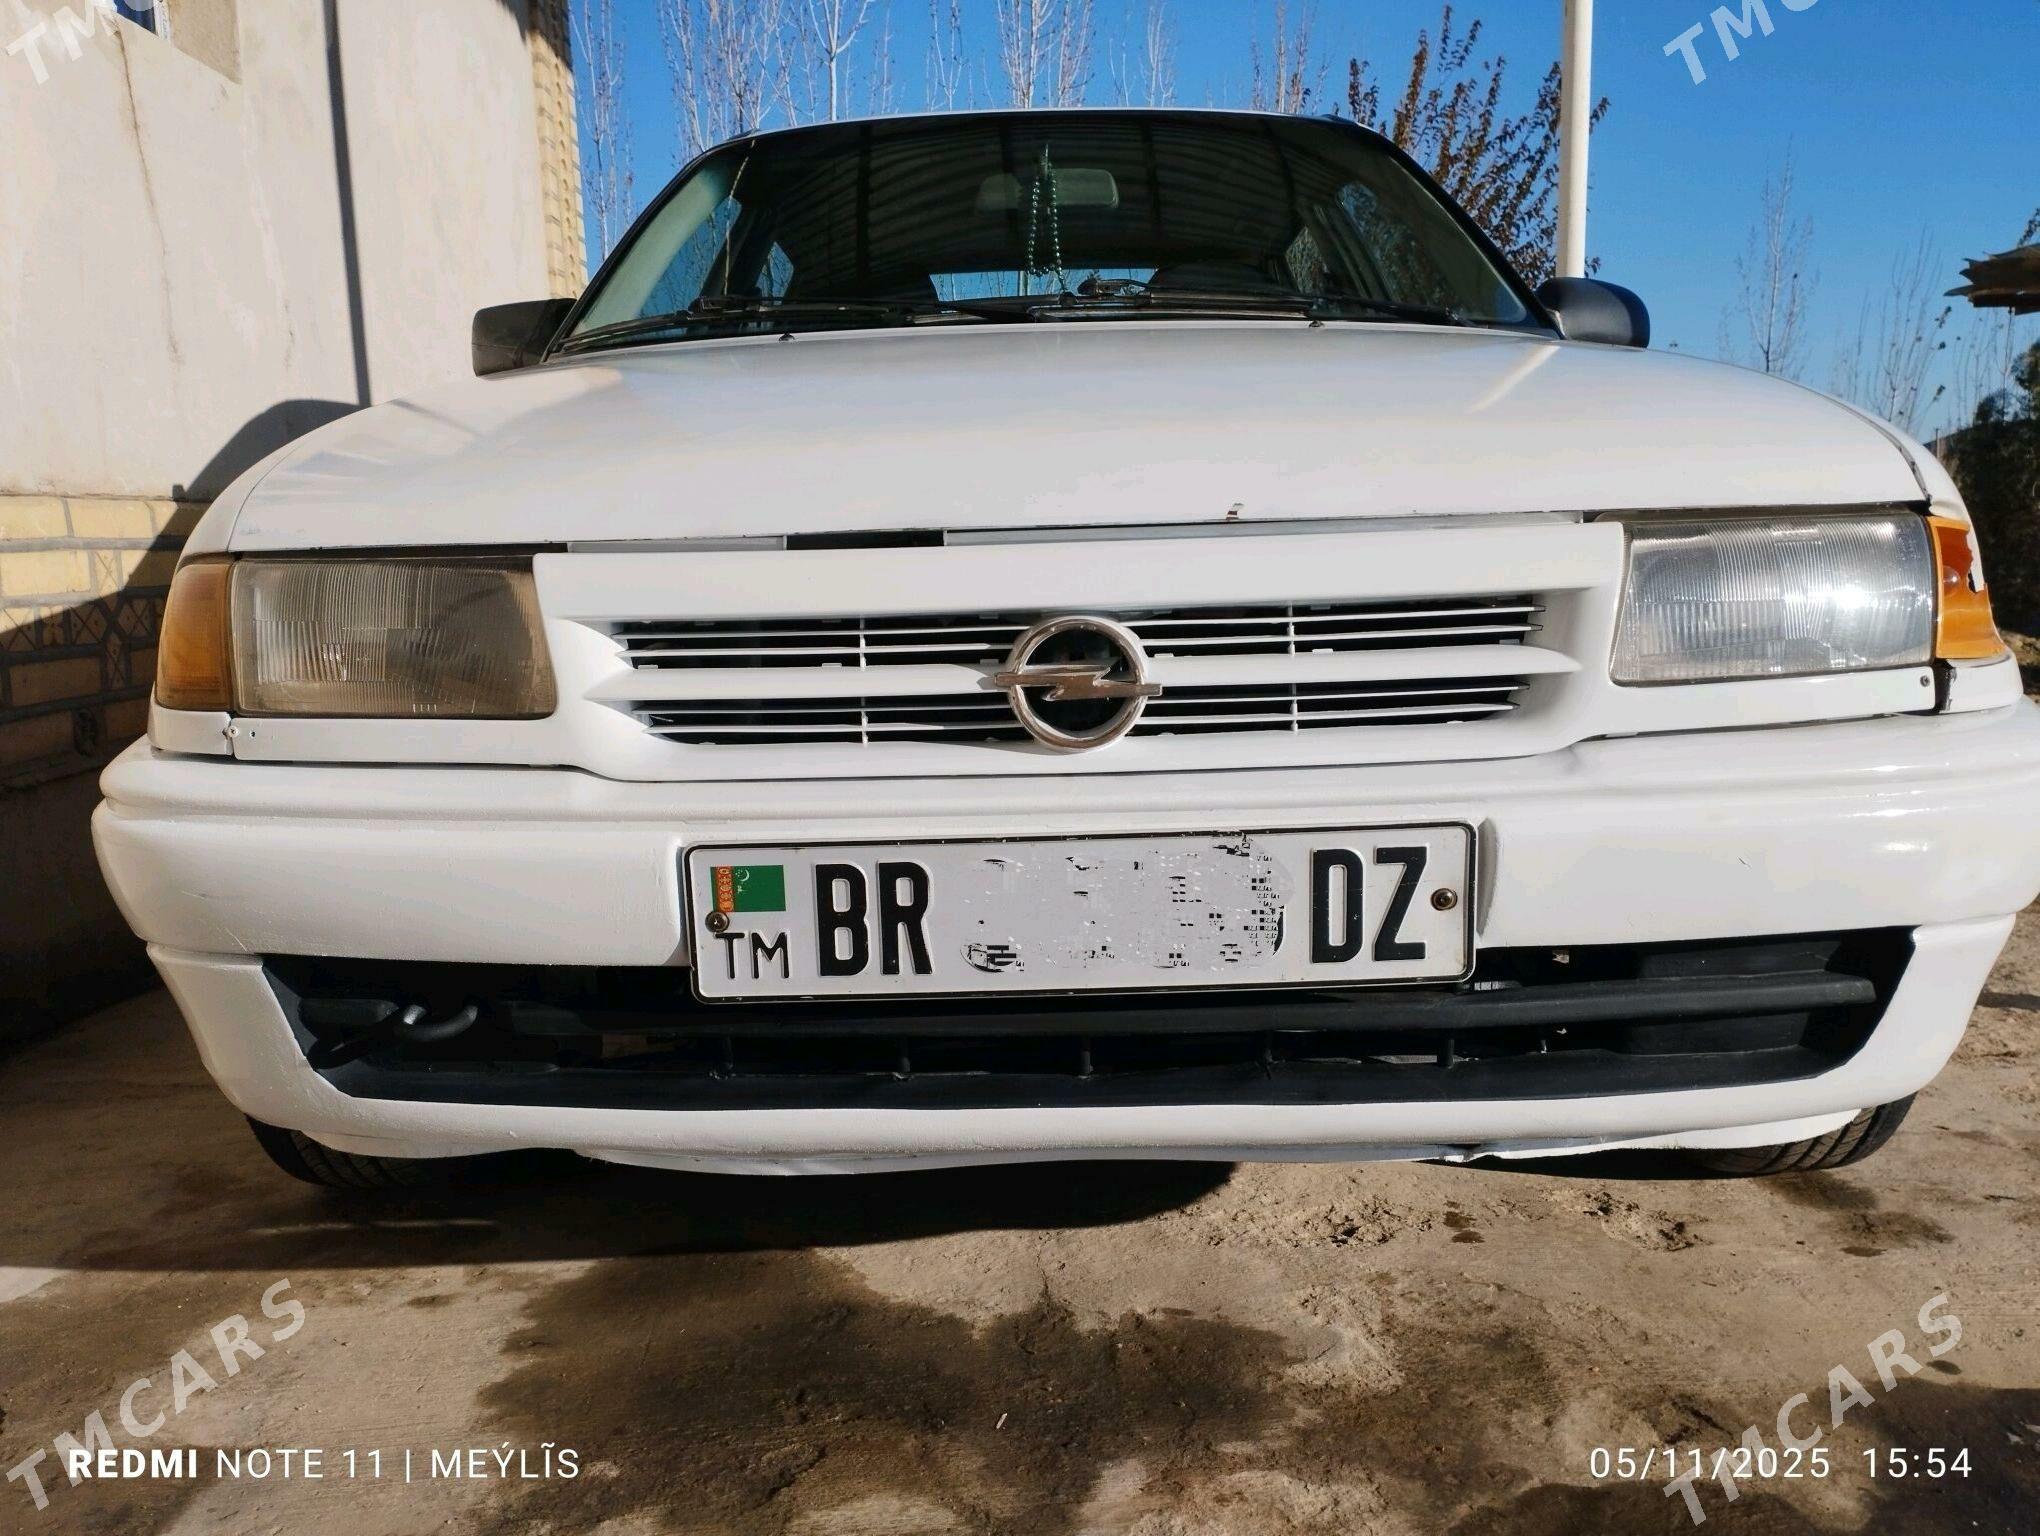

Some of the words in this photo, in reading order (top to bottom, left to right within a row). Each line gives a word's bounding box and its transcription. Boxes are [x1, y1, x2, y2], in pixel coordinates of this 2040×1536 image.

[815, 862, 933, 976] BR
[1312, 846, 1428, 964] DZ
[714, 932, 790, 979] TM
